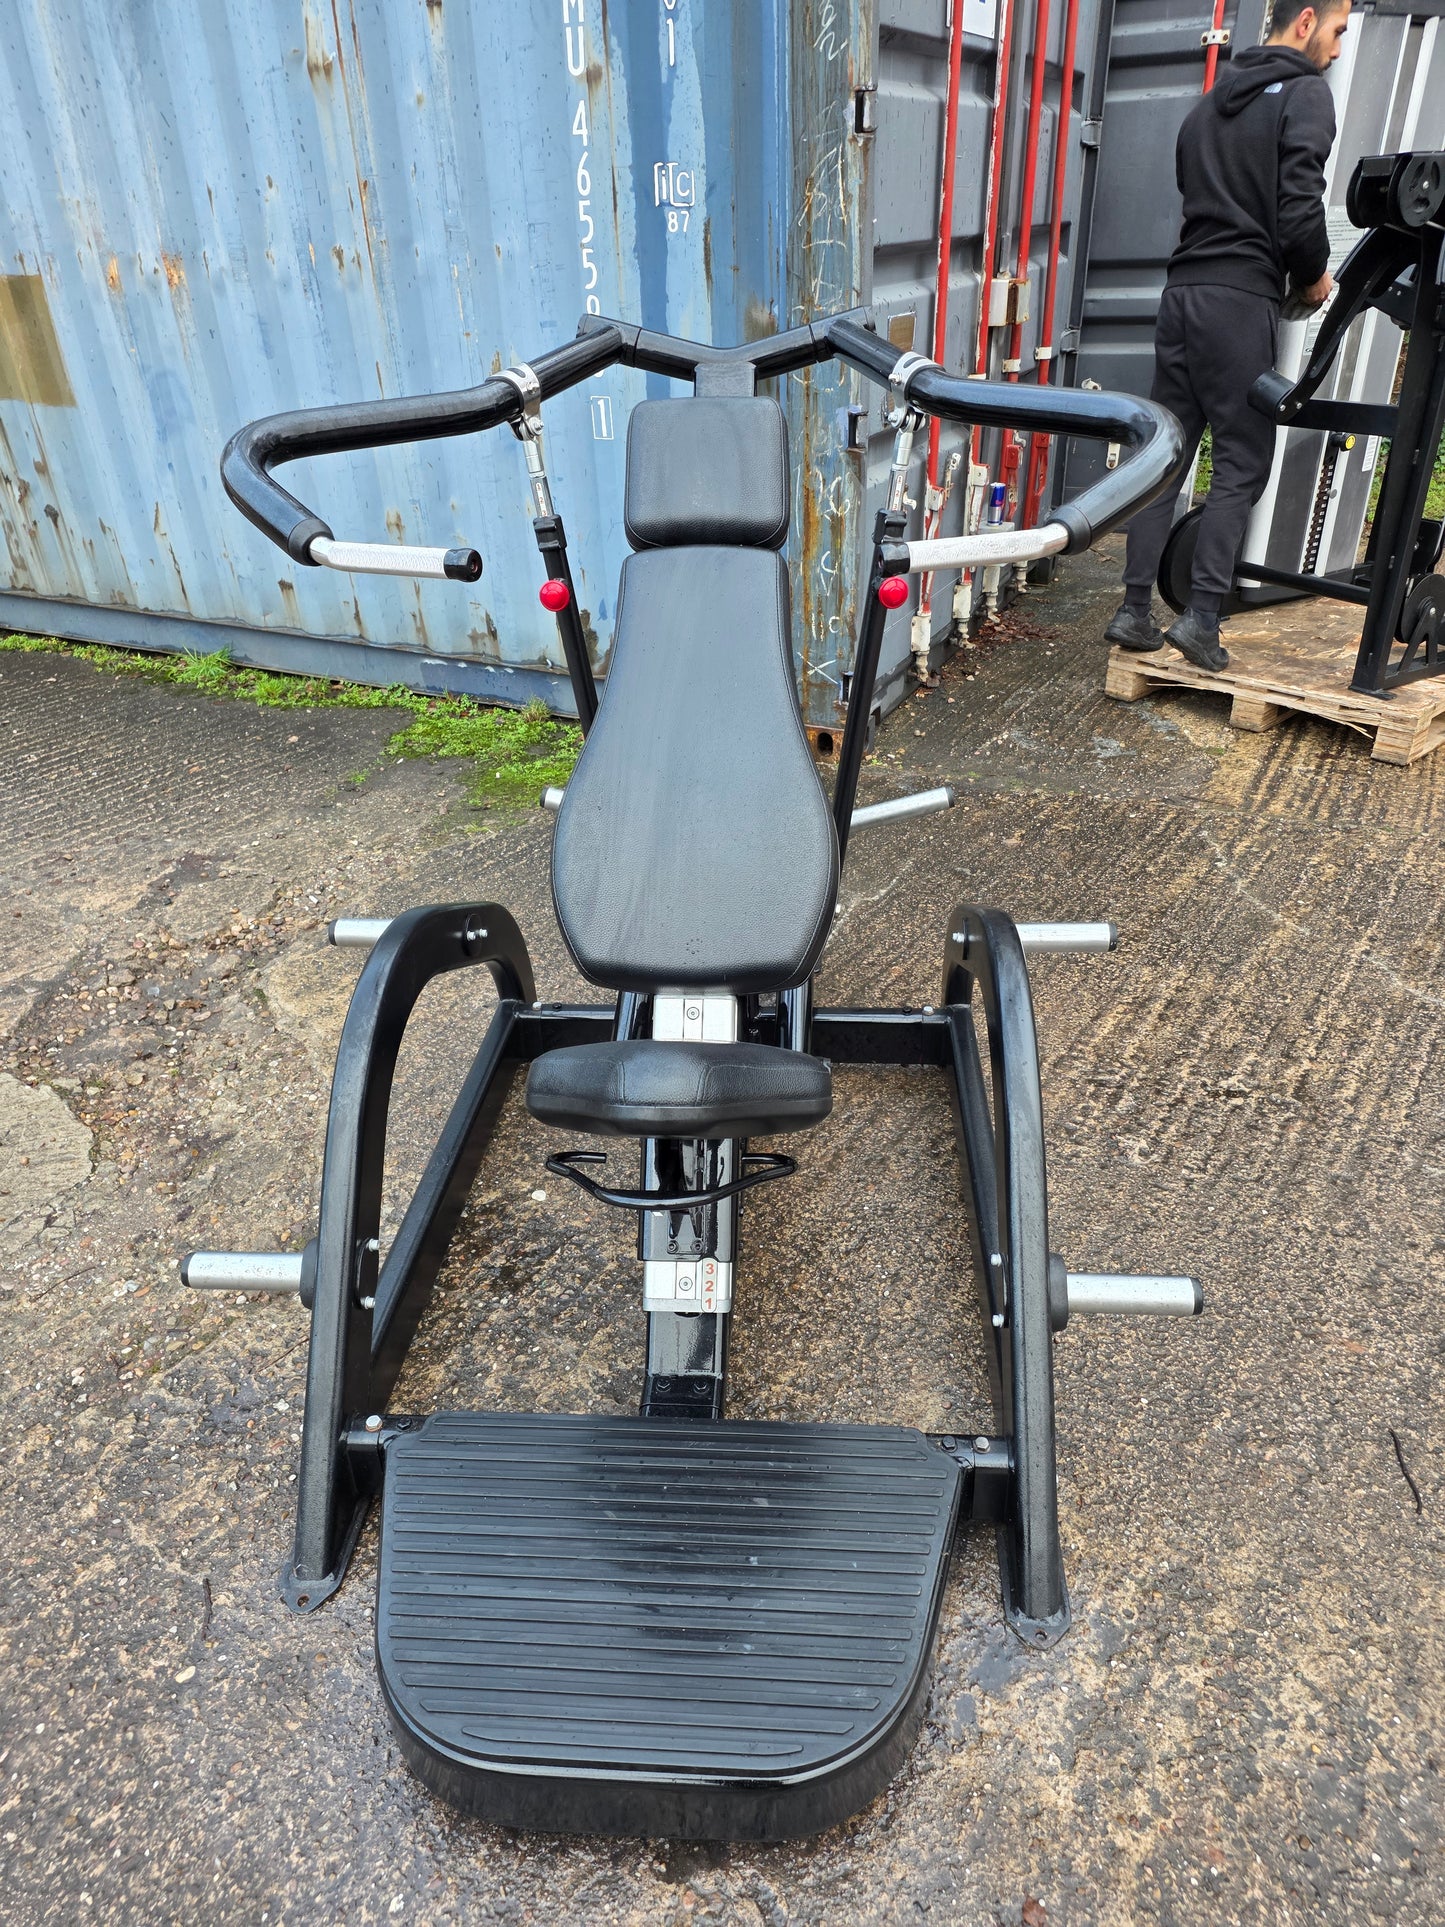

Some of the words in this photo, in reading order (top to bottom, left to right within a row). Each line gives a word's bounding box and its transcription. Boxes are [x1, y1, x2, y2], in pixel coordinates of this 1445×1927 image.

[667, 210, 690, 233] 87
[705, 1263, 715, 1275] 3
[705, 1280, 714, 1292] 2
[705, 1298, 712, 1309] 1
